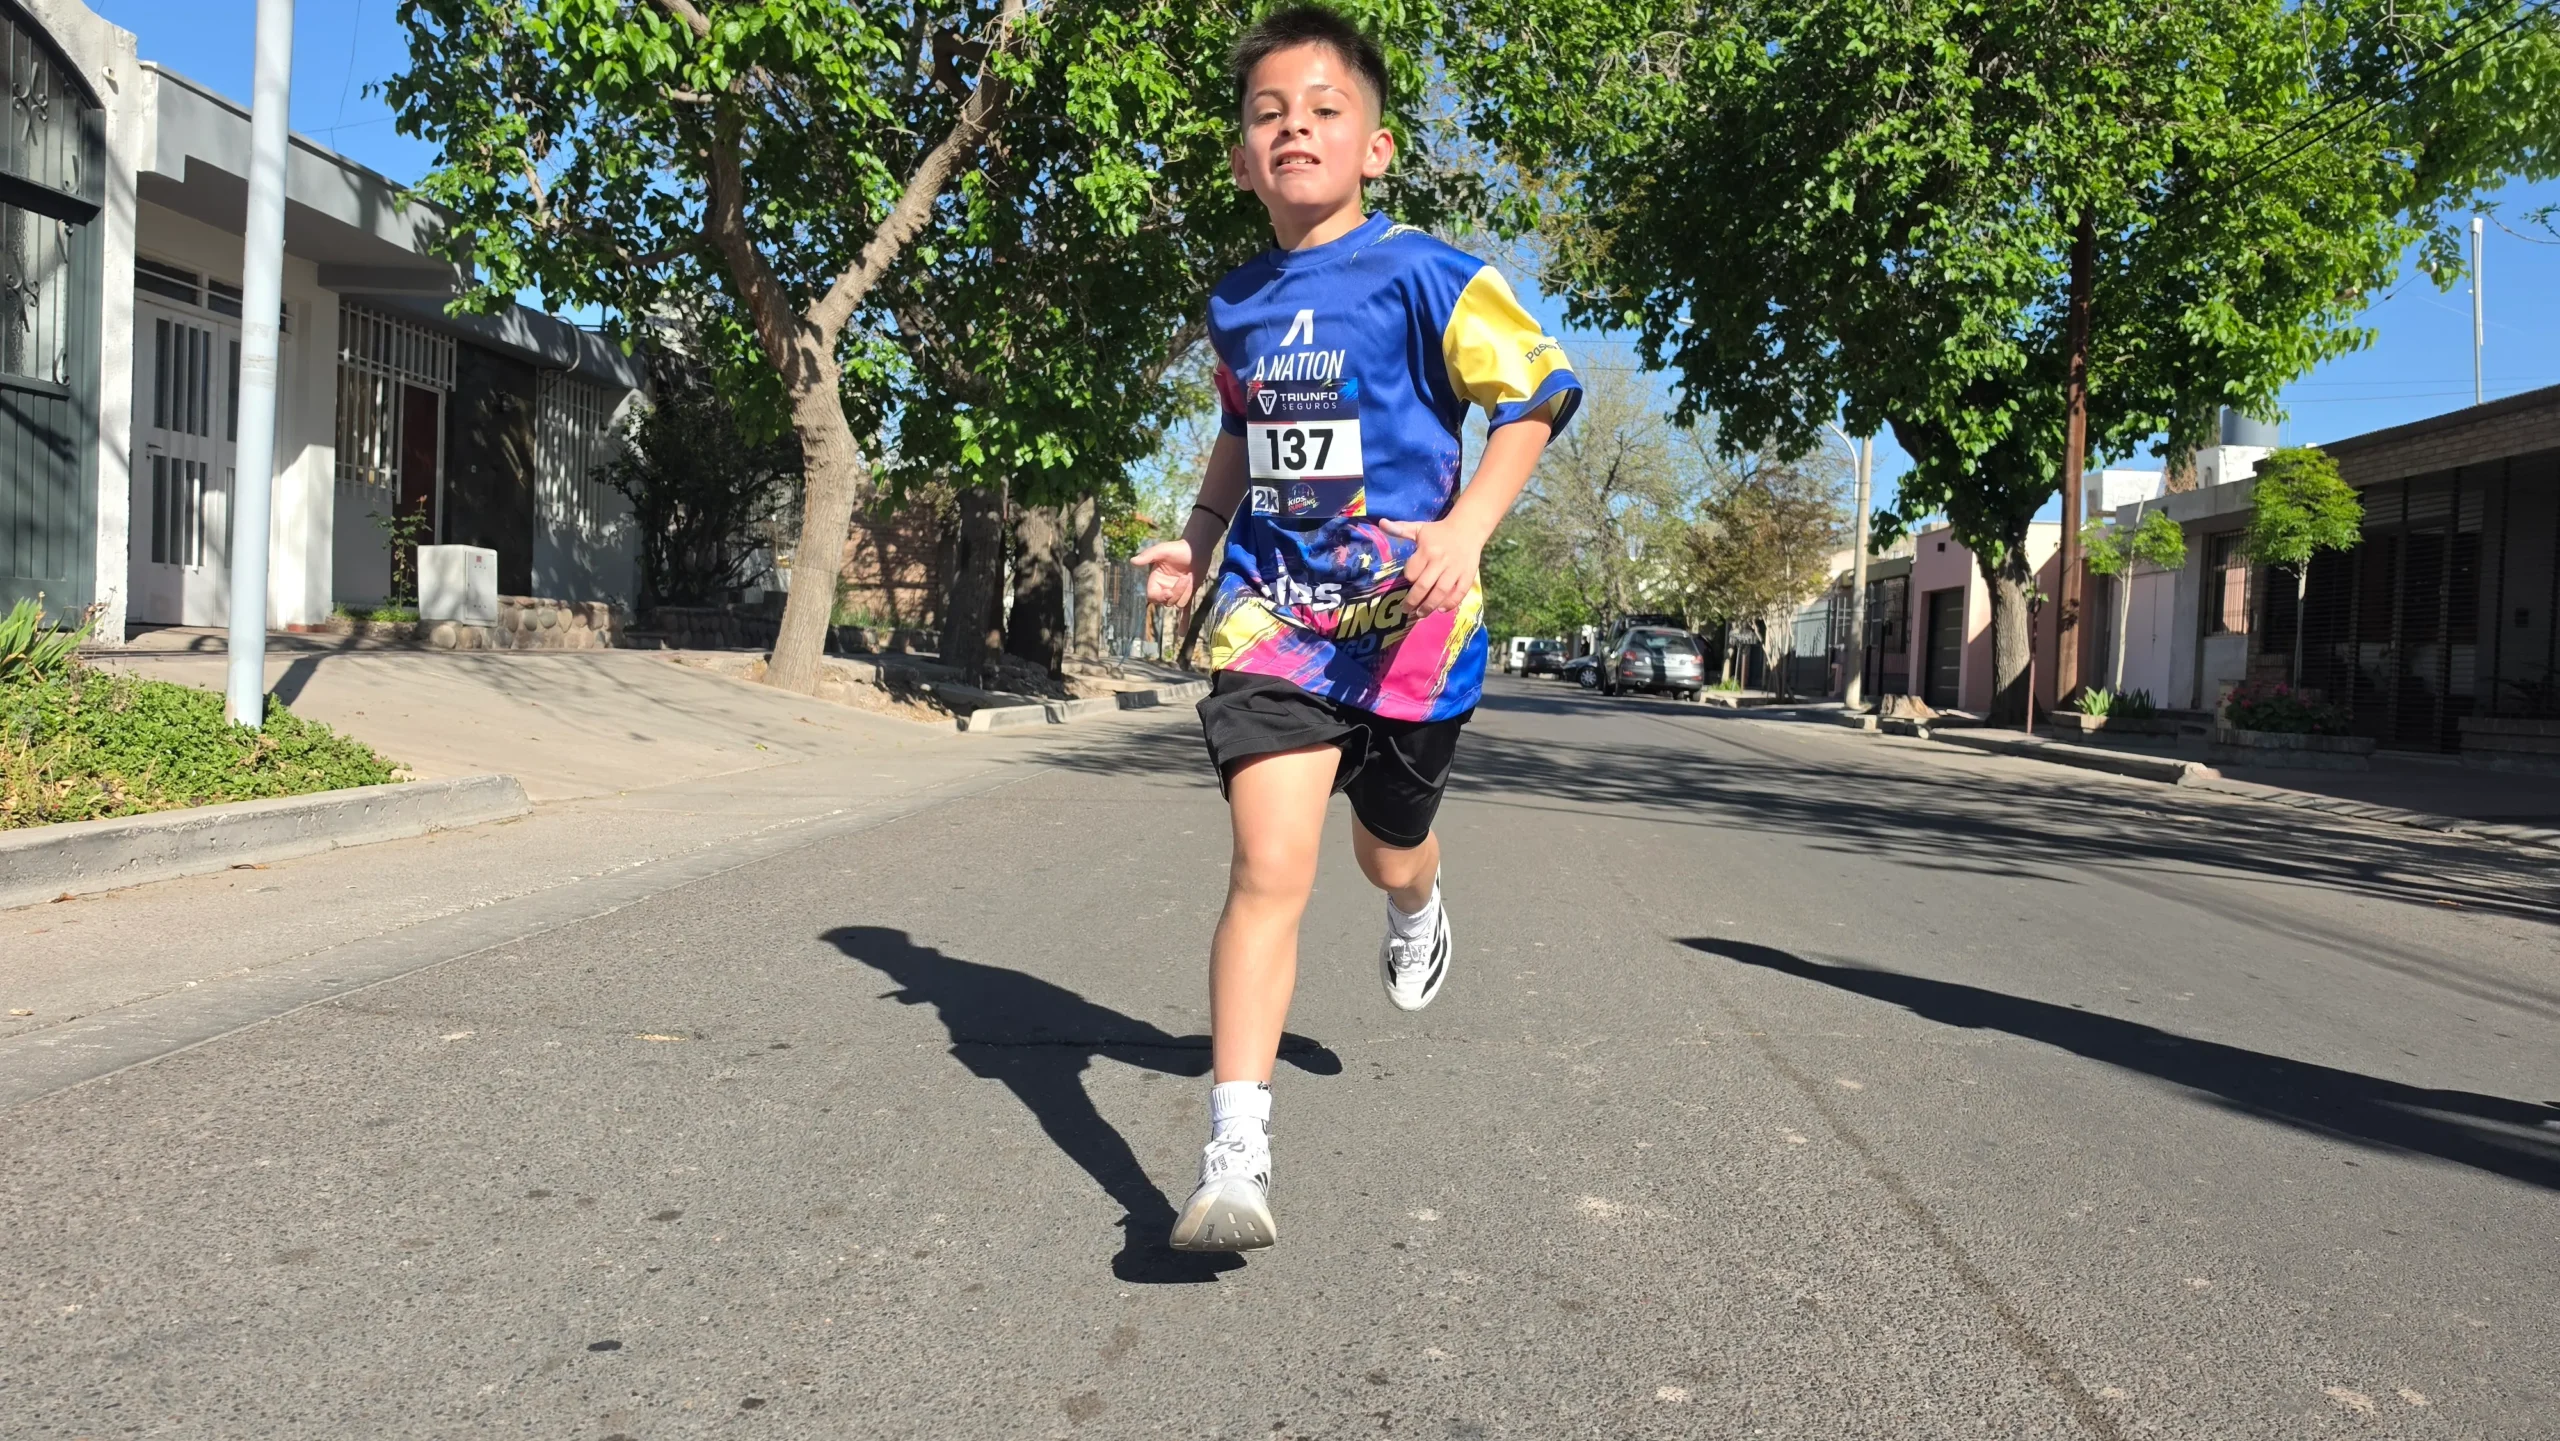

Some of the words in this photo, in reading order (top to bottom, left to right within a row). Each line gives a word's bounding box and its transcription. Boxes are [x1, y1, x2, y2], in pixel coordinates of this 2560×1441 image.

[1253, 356, 1265, 380] A
[1268, 349, 1345, 380] NATION
[1280, 391, 1338, 401] TRIUNFO
[1282, 402, 1337, 410] SEGUROS
[1266, 428, 1334, 471] 137
